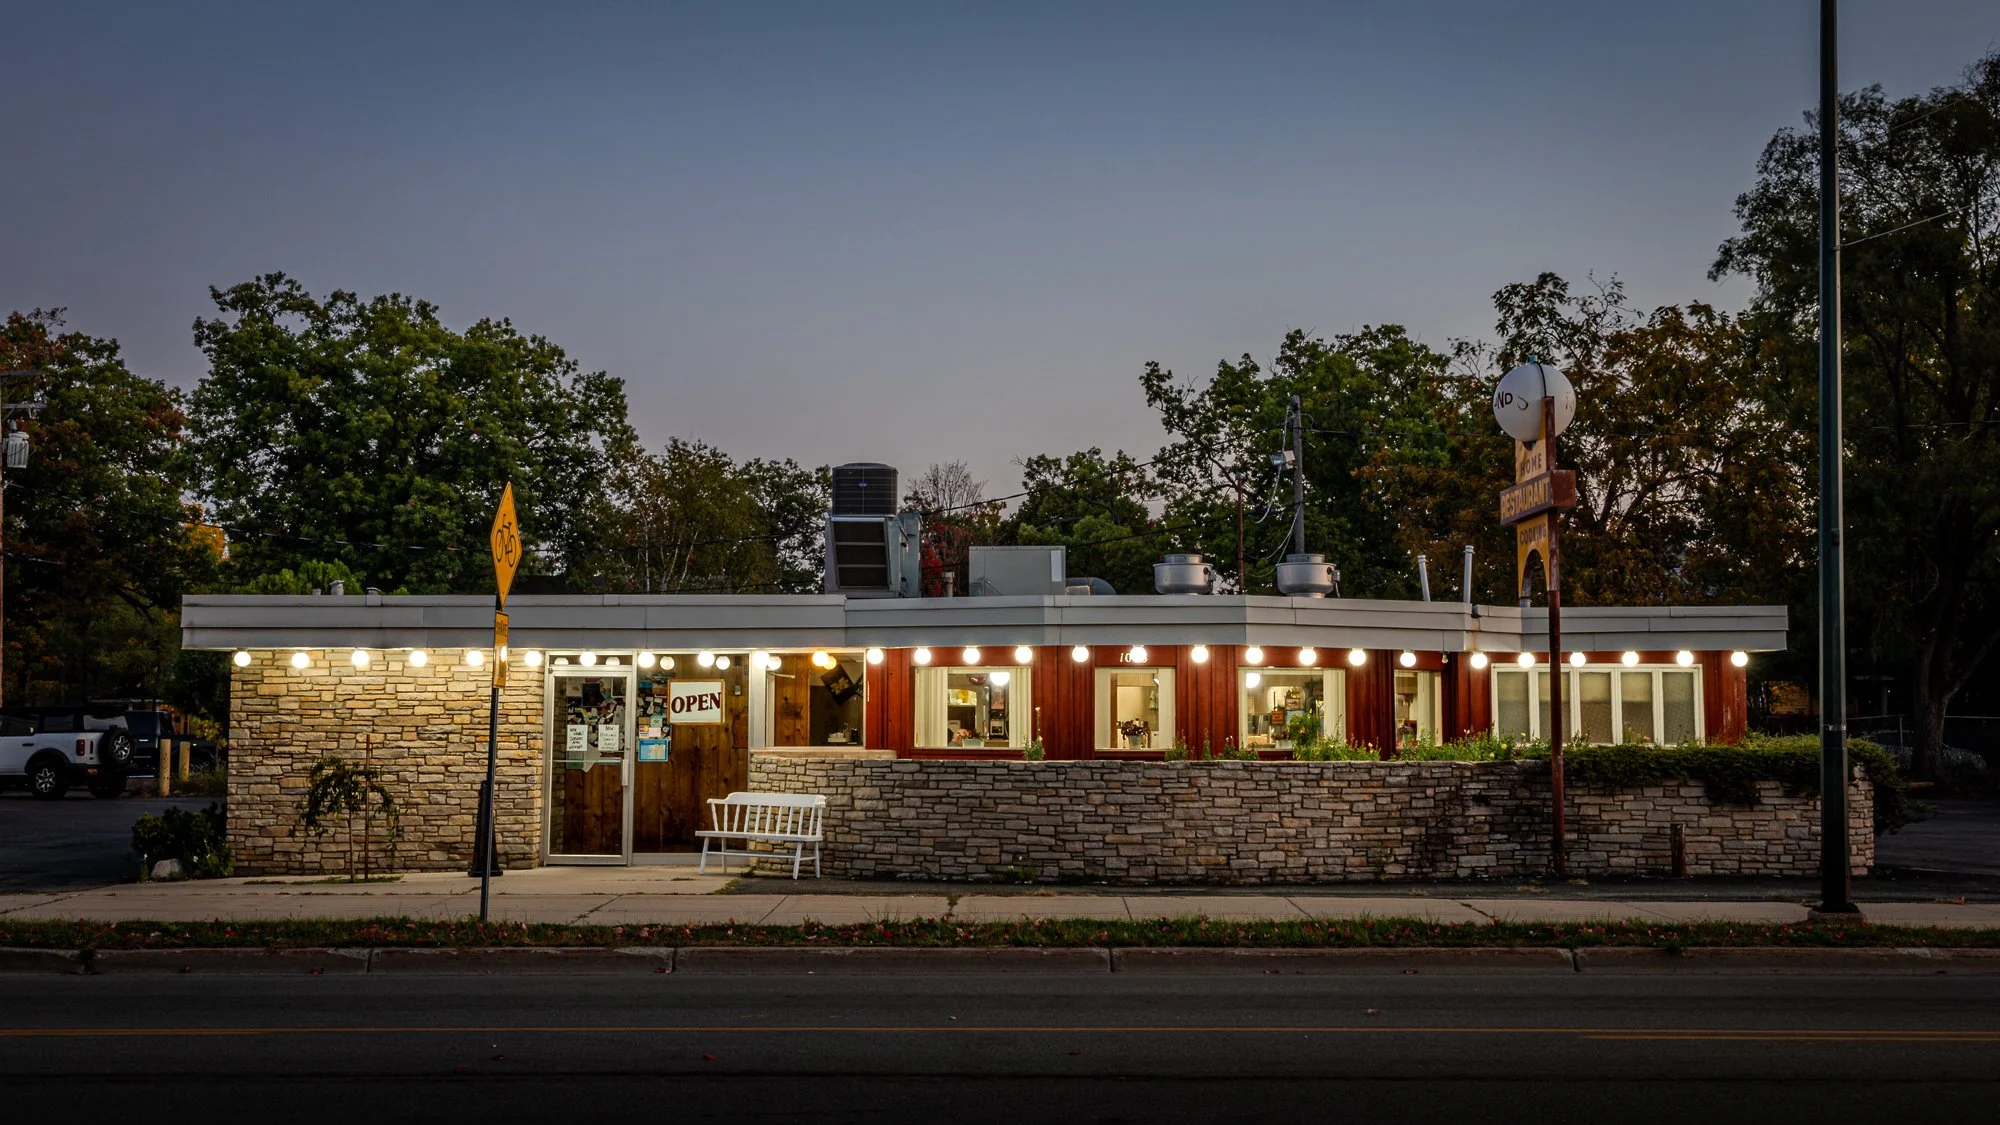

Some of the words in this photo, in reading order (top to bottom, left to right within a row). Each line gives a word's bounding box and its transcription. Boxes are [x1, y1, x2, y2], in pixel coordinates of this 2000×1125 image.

[1520, 453, 1542, 476] HOME
[1501, 478, 1550, 520] RESTAURANT
[1519, 522, 1546, 545] COOKING
[671, 692, 722, 713] OPEN
